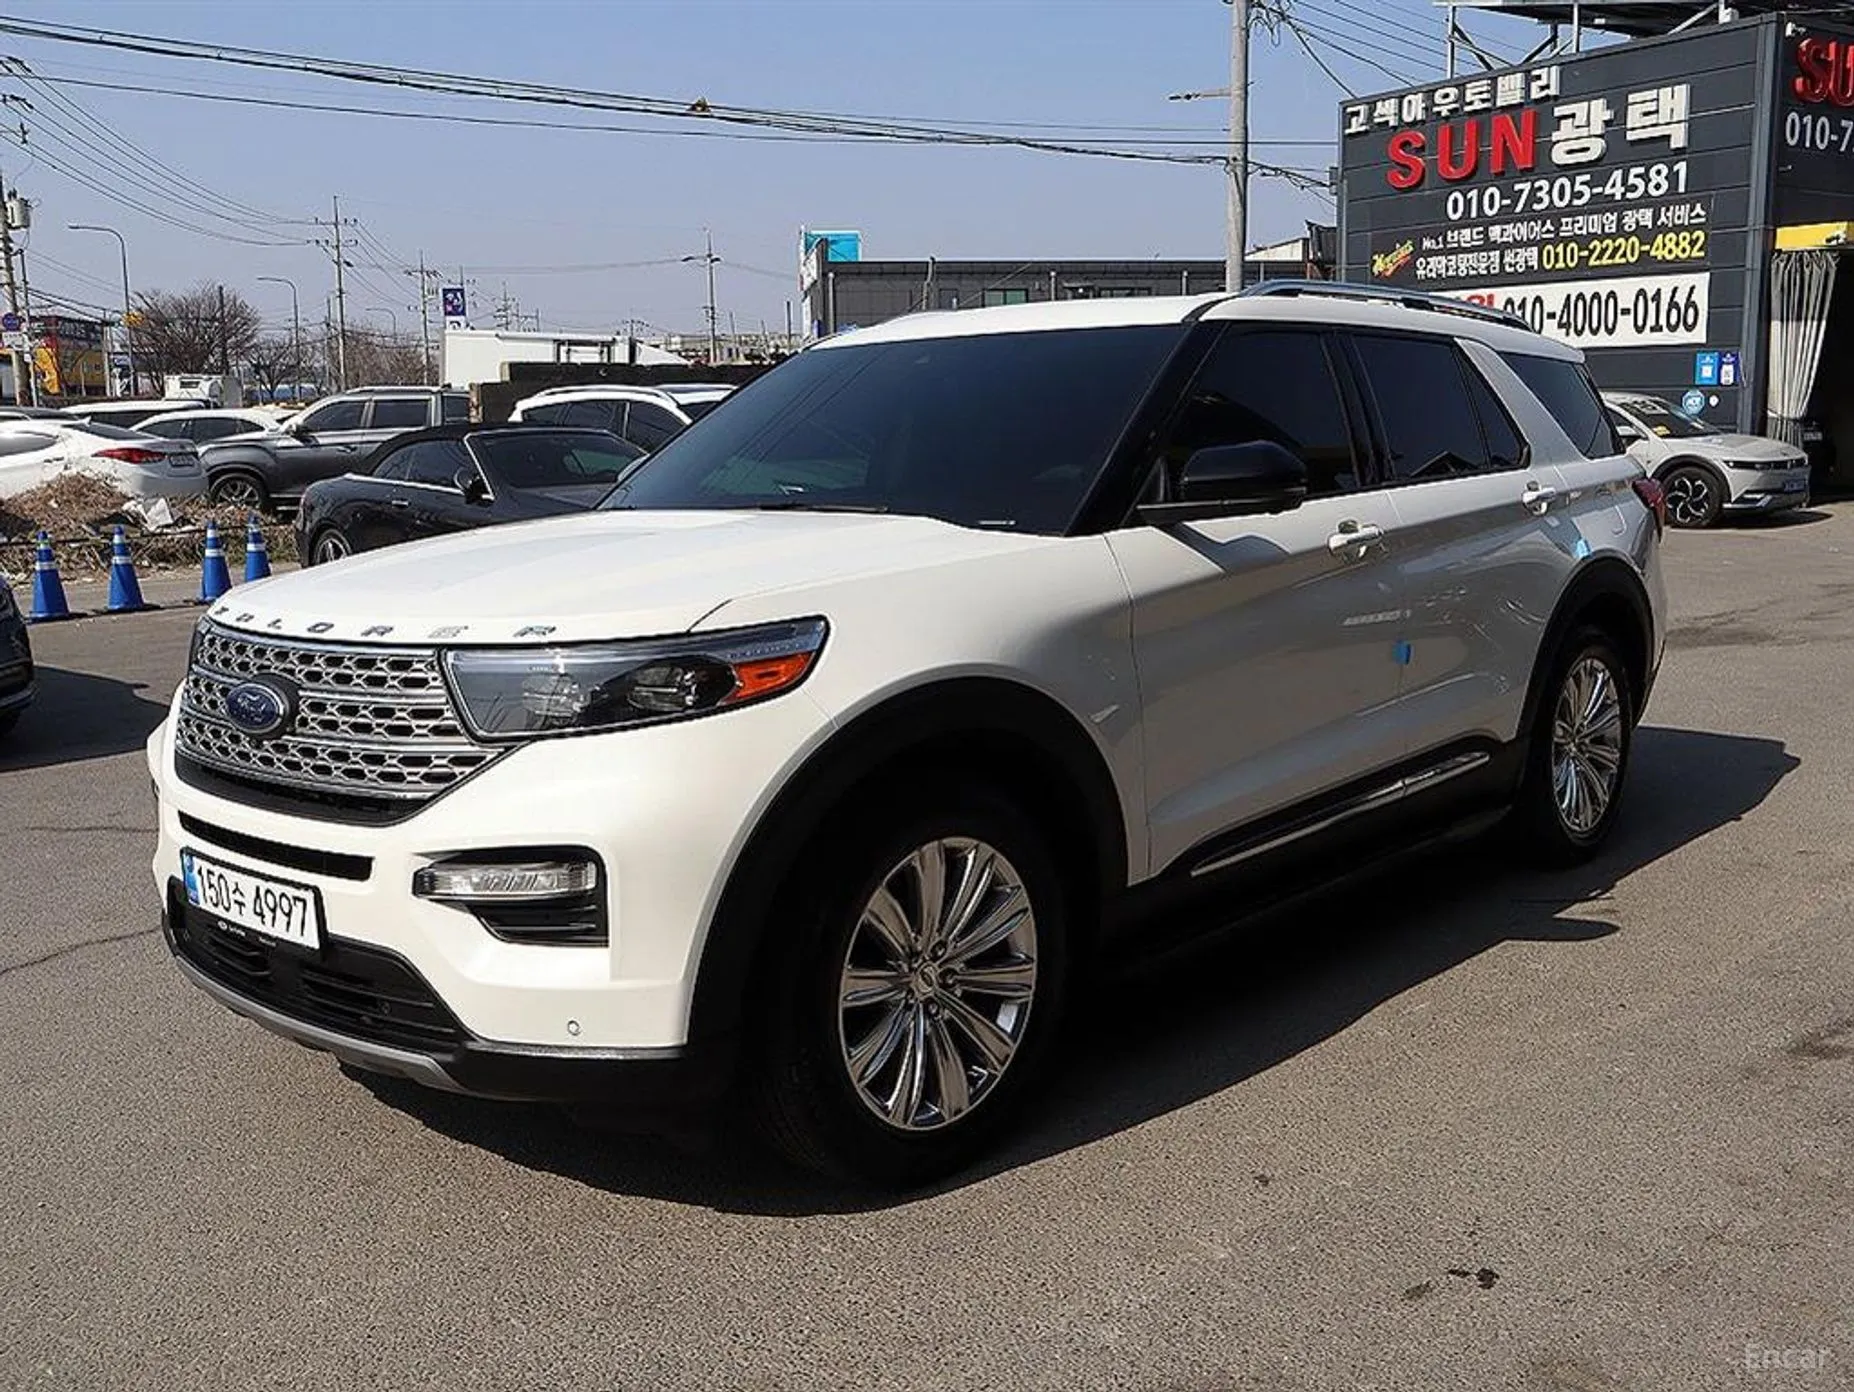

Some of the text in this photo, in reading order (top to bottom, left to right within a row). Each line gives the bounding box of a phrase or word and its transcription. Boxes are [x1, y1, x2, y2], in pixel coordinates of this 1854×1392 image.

[1387, 83, 1691, 188] SUN 광택
[1446, 161, 1688, 221] 010-7305-4581
[1559, 212, 1618, 237] 프리미엄
[1622, 208, 1654, 232] 광택
[1657, 203, 1707, 228] 서비스
[1542, 230, 1706, 270] 010-2220-4882
[197, 866, 308, 937] 150수 4997
